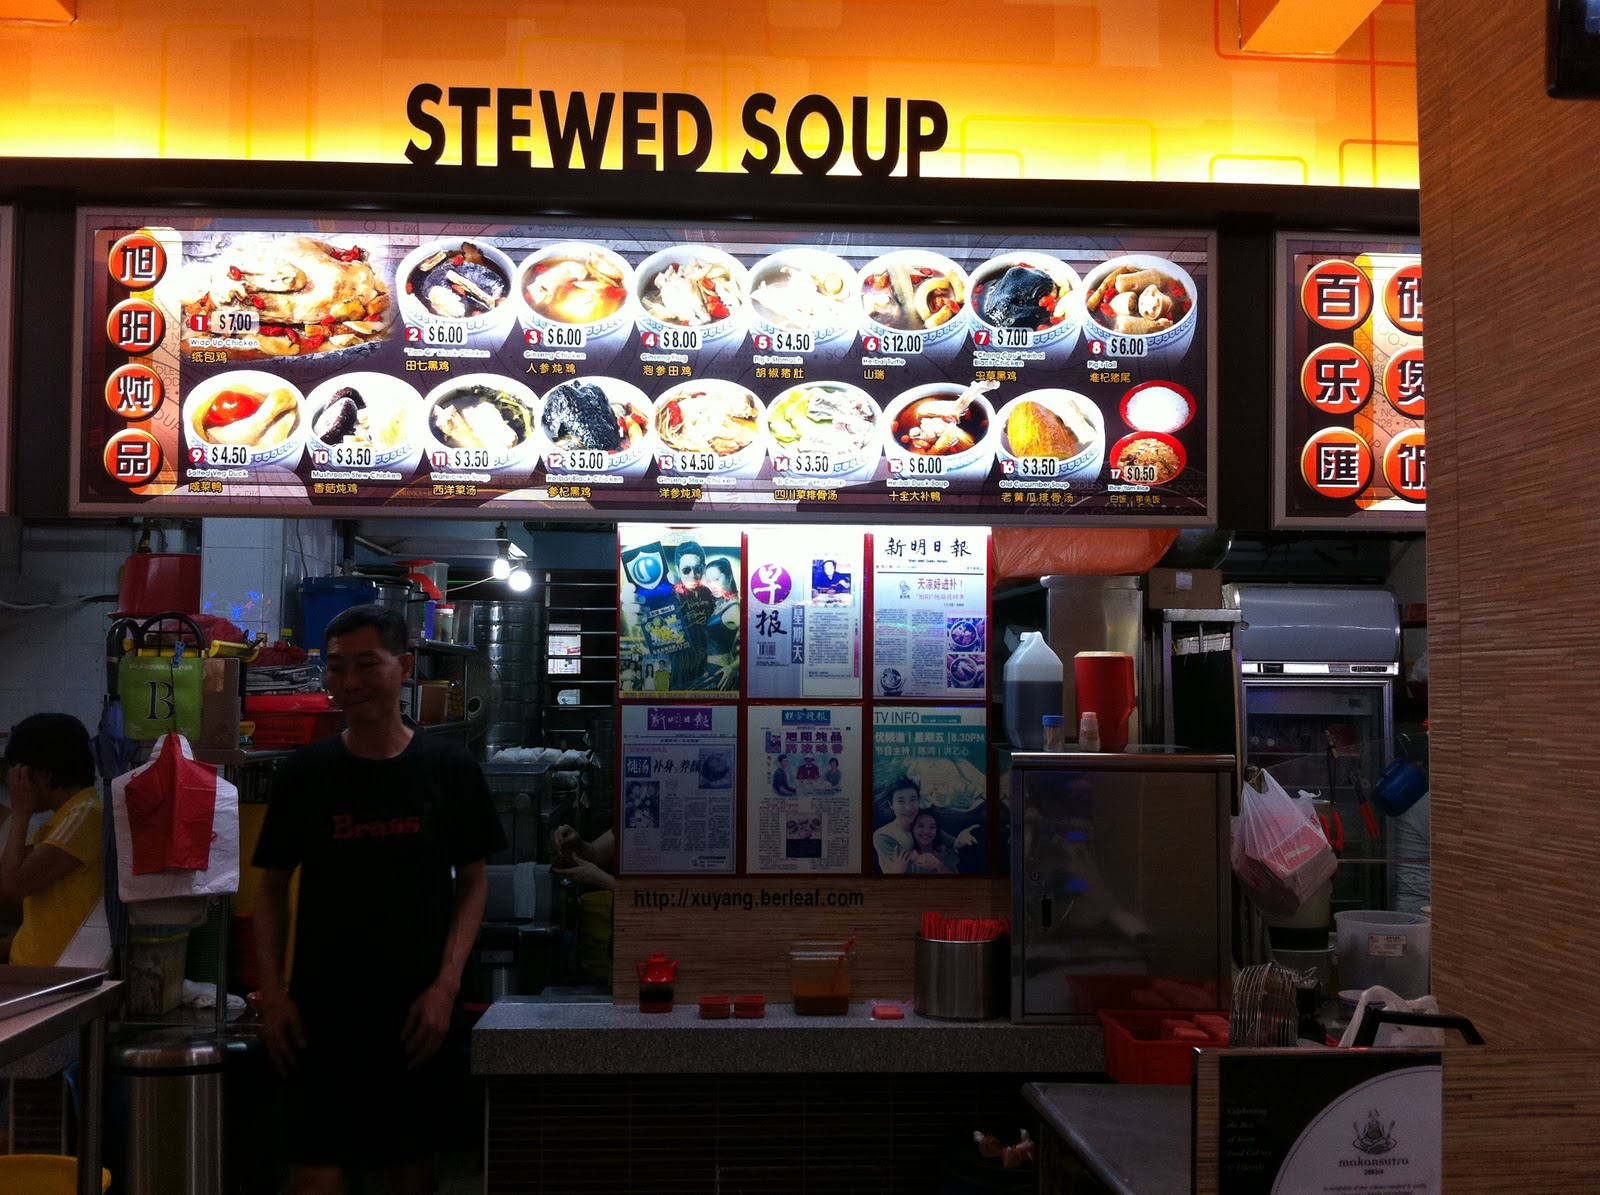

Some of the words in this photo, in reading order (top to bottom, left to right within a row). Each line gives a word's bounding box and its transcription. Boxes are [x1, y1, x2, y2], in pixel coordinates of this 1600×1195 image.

[404, 83, 713, 171] STEWED
[741, 92, 949, 177] SOUP
[195, 315, 204, 331] 1
[408, 327, 419, 341] 2
[528, 330, 539, 344] 3
[645, 333, 656, 347] 4
[979, 331, 988, 345] 7
[190, 338, 211, 348] Wrap
[212, 338, 224, 348] Up
[225, 338, 259, 348] Chicken
[757, 336, 768, 349] 5
[866, 337, 877, 351] 6
[1091, 340, 1102, 354] 8
[191, 351, 228, 363] 纸包鸡
[459, 350, 491, 358] Chicken
[524, 350, 554, 360] Ginseng
[555, 351, 586, 360] Chicken
[641, 353, 670, 362] Ginseng
[671, 354, 688, 363] Frog
[771, 356, 804, 364] Stomach
[1021, 351, 1046, 360] Herbal
[405, 360, 450, 372] 田七黑鸡
[863, 358, 886, 366] Herbal
[887, 358, 906, 366] Turtle
[995, 359, 1025, 367] Chicken
[525, 362, 577, 375] 人参炖鸡
[755, 367, 804, 379] 胡椒猪肚
[975, 370, 1017, 381] 虫草黑鸡
[191, 448, 203, 463] 9
[313, 450, 330, 465] 10
[434, 452, 447, 467] 11
[548, 454, 563, 468] 12
[659, 455, 673, 470] 13
[775, 457, 789, 472] 14
[888, 459, 903, 473] 15
[1001, 460, 1016, 474] 16
[186, 469, 211, 477] Salted
[212, 469, 228, 478] Veg
[228, 469, 249, 477] Duck
[311, 470, 350, 479] Mushroom
[370, 472, 402, 480] Chicken
[546, 474, 571, 482] Herbal
[572, 474, 592, 482] Black
[593, 475, 624, 483] Chicken
[1110, 468, 1121, 480] 17
[657, 475, 687, 485] Ginseng
[688, 475, 705, 483] Stew
[706, 476, 736, 484] Chicken
[886, 480, 911, 488] Herbal
[911, 480, 931, 488] Duck
[931, 480, 950, 489] Soup
[999, 480, 1013, 488] Old
[1014, 480, 1050, 489] Cucumber
[1051, 480, 1070, 489] Soup
[313, 482, 358, 495] 香菇炖鸡
[432, 484, 478, 496] 西洋菜汤
[659, 487, 703, 499] 洋参炖鸡
[774, 489, 839, 501] 四川菜排骨汤
[888, 490, 941, 502] 十全大补鸭
[1001, 492, 1075, 503] 老黄瓜排骨汤
[884, 537, 972, 558] 新明日報
[792, 605, 805, 664] 星期天
[144, 681, 176, 721] B
[874, 712, 889, 723] TV
[892, 712, 919, 724] INFO
[626, 758, 650, 775] 炖汤
[633, 889, 864, 911] http://xuyang.berleaf.com
[1338, 1156, 1410, 1168] makansutra
